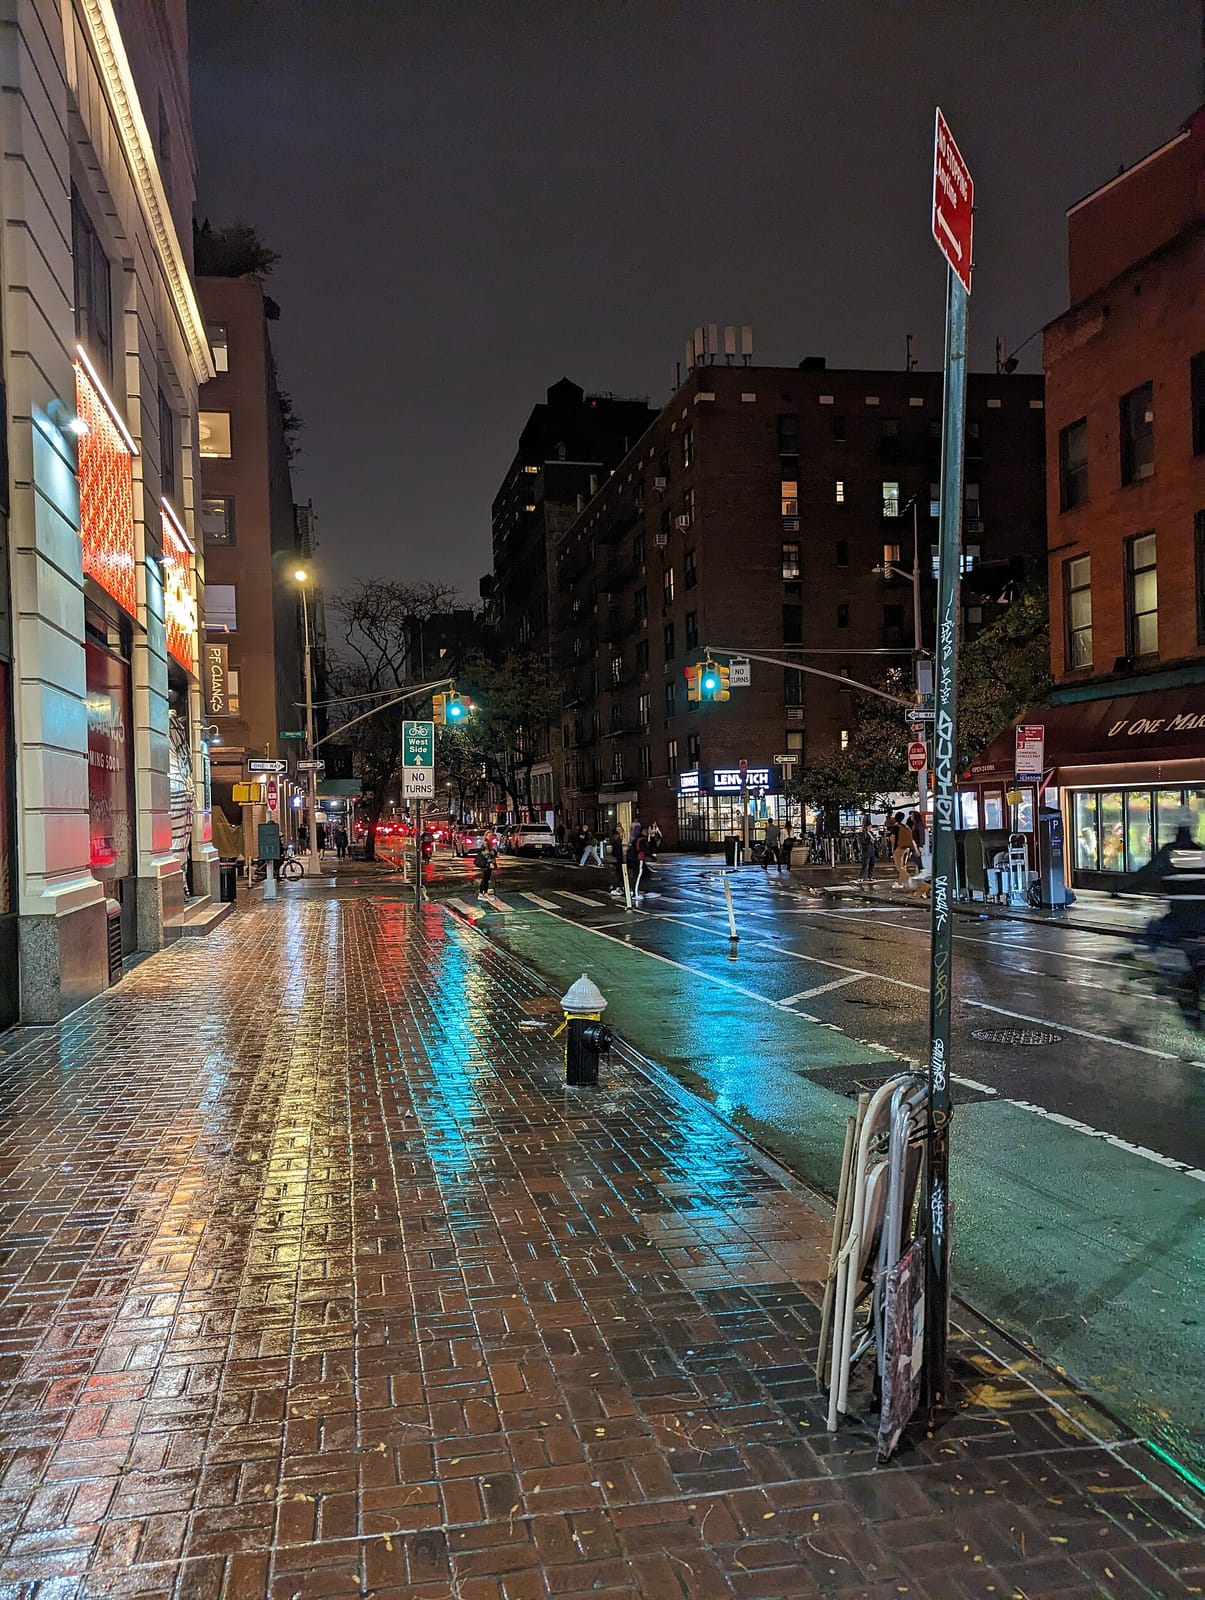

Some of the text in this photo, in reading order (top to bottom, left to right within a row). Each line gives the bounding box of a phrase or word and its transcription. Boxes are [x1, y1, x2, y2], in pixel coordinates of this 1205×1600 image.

[208, 648, 224, 713] P.F. CHANG'S
[731, 676, 749, 684] TURNS
[1107, 720, 1129, 737] U
[1127, 718, 1166, 736] ONE
[408, 738, 428, 746] West
[411, 772, 425, 782] NO
[405, 784, 432, 793] TURNS
